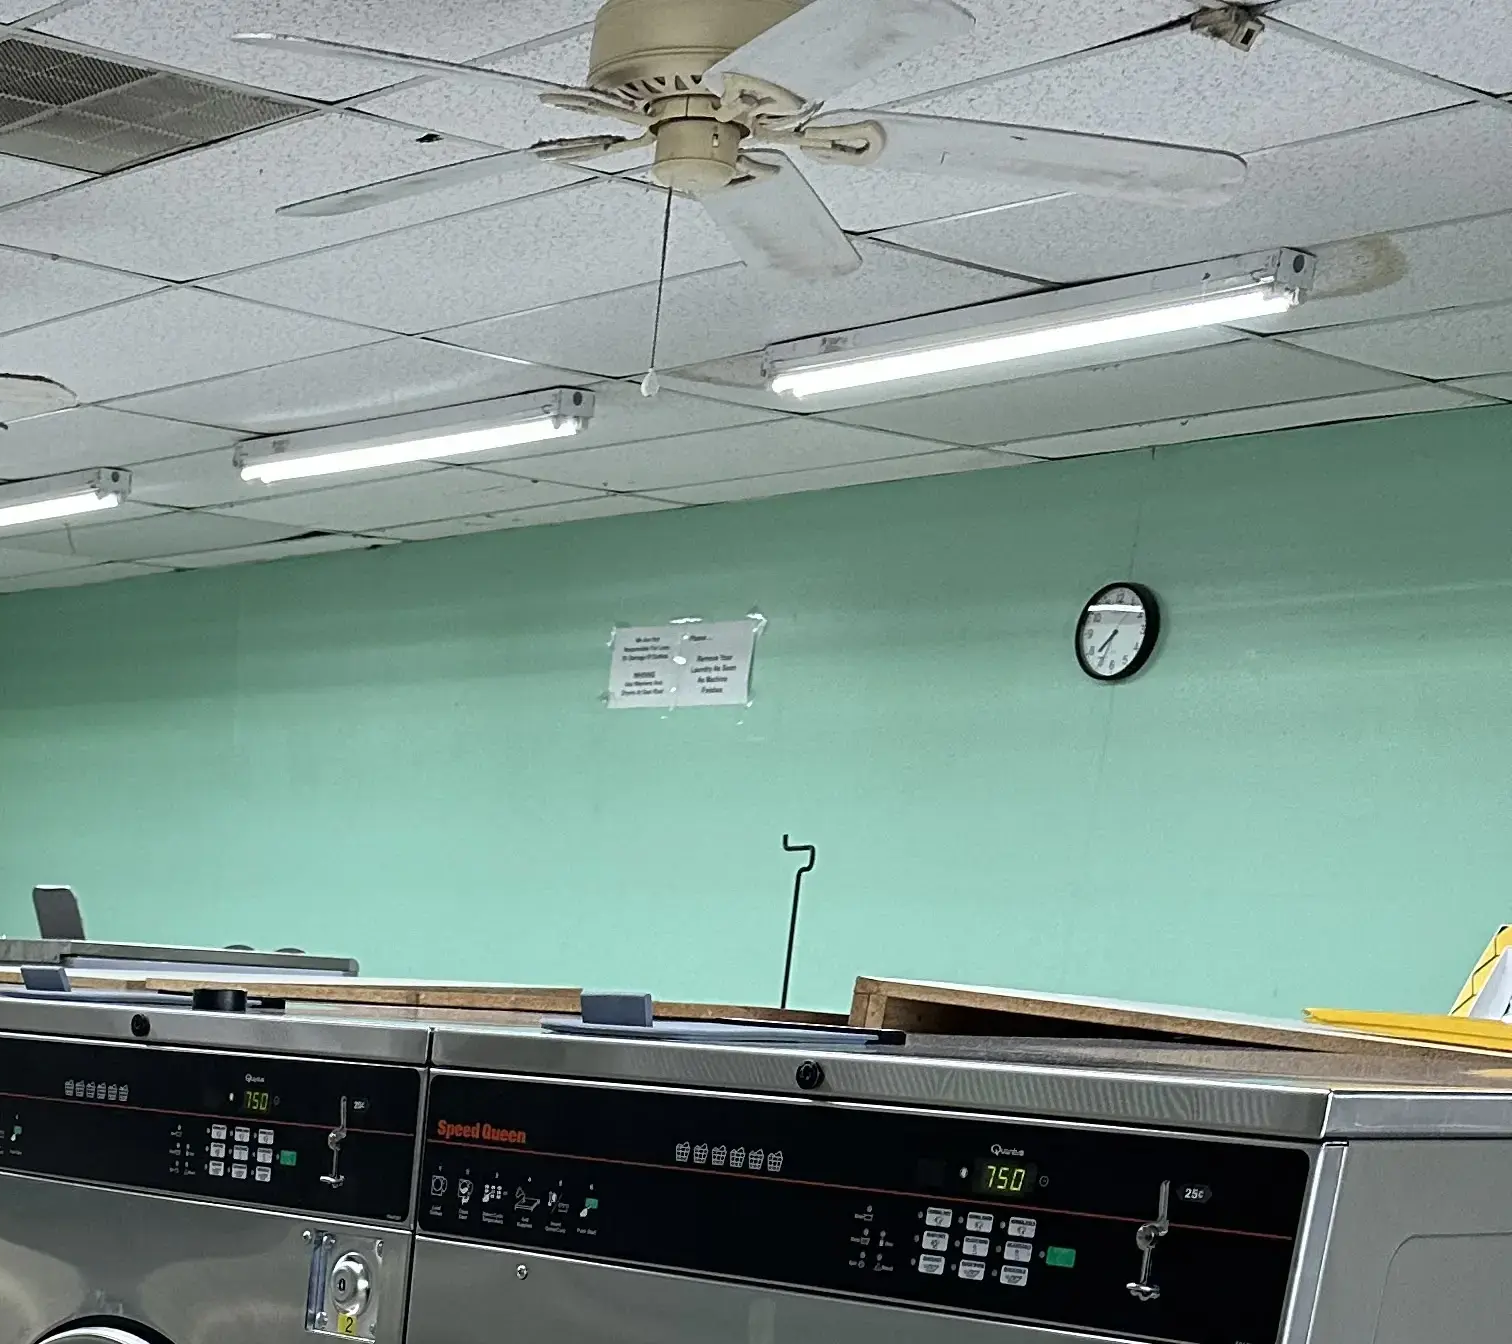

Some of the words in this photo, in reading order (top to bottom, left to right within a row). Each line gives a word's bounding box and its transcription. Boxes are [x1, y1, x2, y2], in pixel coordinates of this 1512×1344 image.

[245, 1090, 269, 1110] 750
[437, 1119, 481, 1140] Speed
[481, 1123, 527, 1144] Queen
[987, 1165, 1026, 1191] 750
[344, 1316, 354, 1333] 2
